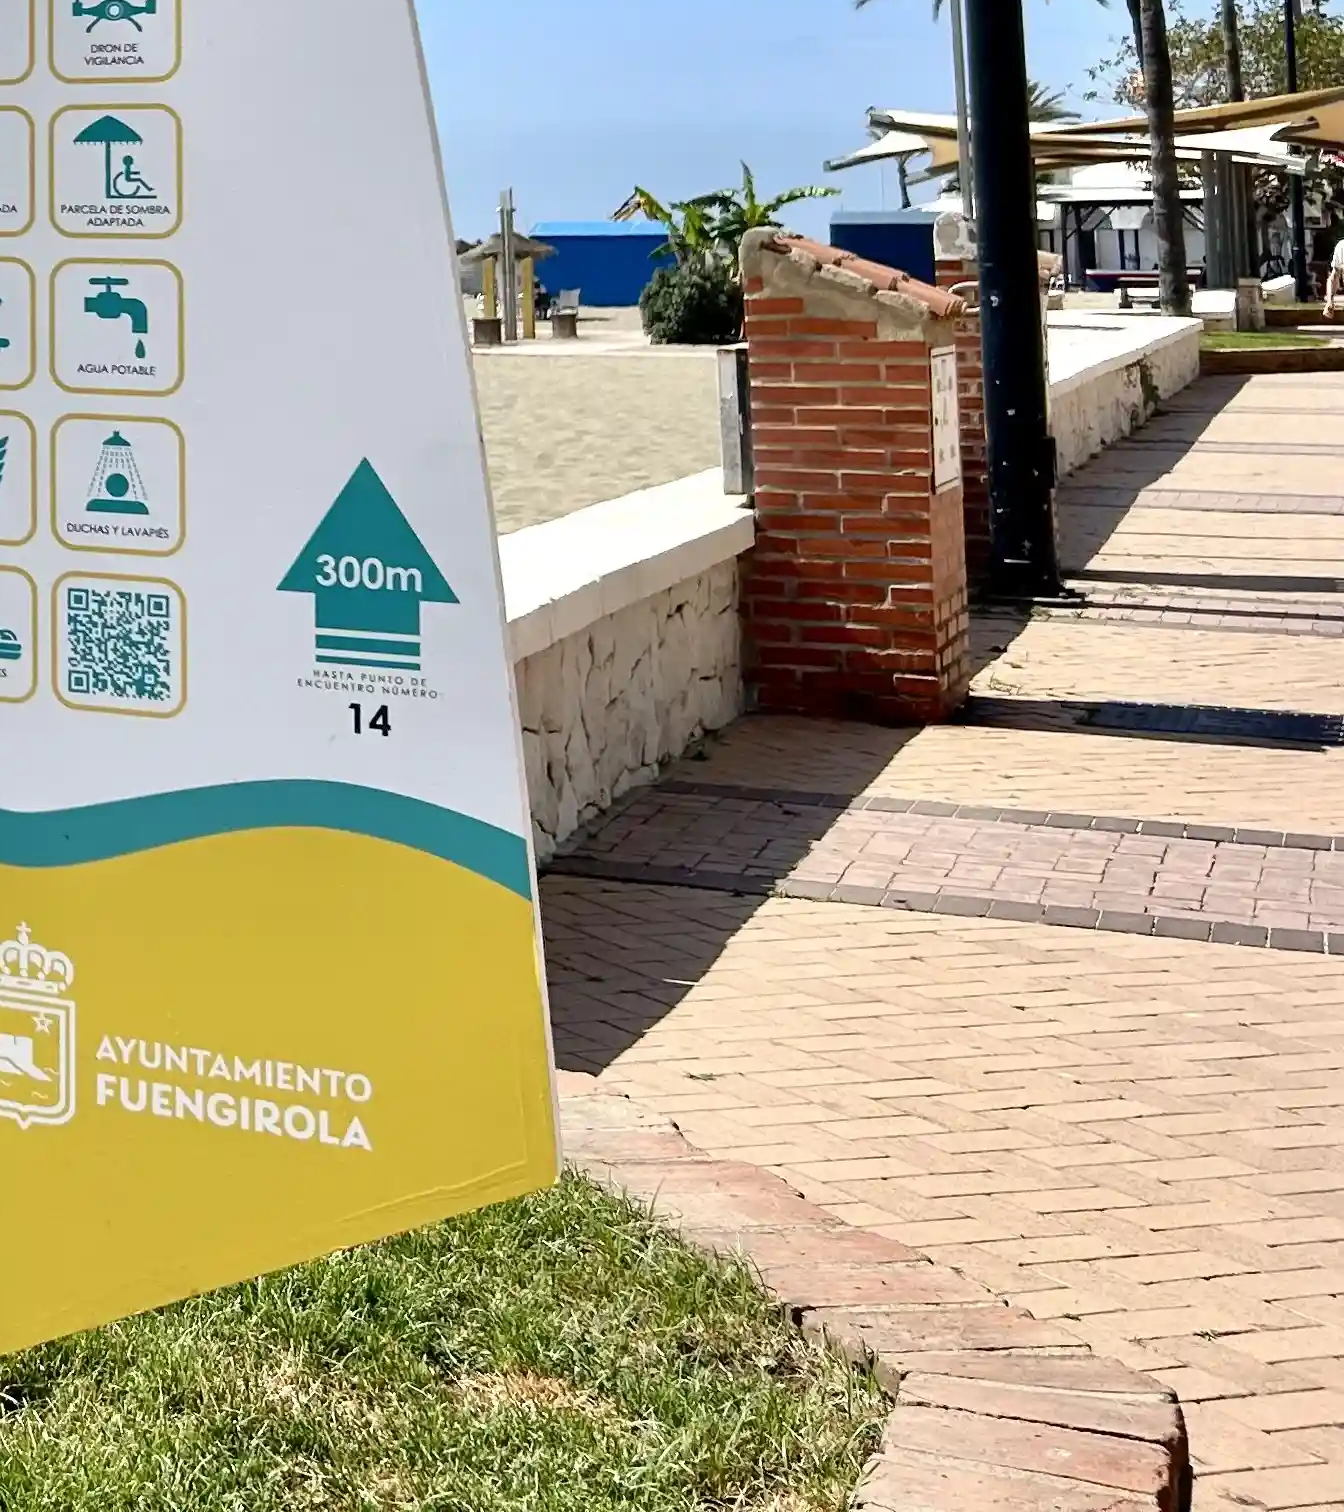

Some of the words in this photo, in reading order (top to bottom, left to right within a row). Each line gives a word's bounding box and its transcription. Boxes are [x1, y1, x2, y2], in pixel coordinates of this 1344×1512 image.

[90, 44, 122, 54] DRON
[123, 43, 140, 54] DE
[83, 55, 145, 67] VIGILANCIA
[60, 204, 108, 216] PARCELA
[109, 204, 125, 215] DE
[125, 204, 172, 216] SOMBRA
[86, 217, 144, 228] ADAPTADA
[76, 363, 110, 375] AGUA
[111, 364, 157, 378] POTABLE
[65, 522, 110, 536] DUCHAS
[111, 525, 120, 537] Y
[315, 553, 423, 593] 300m
[296, 677, 376, 694] ENCUENTRO
[312, 669, 354, 681] HASTA
[360, 672, 404, 686] PUNTO
[410, 677, 427, 688] DE
[348, 701, 392, 738] 14
[95, 1034, 373, 1103] AYUNTAMIENTO
[95, 1072, 374, 1152] FUENGIROLA
